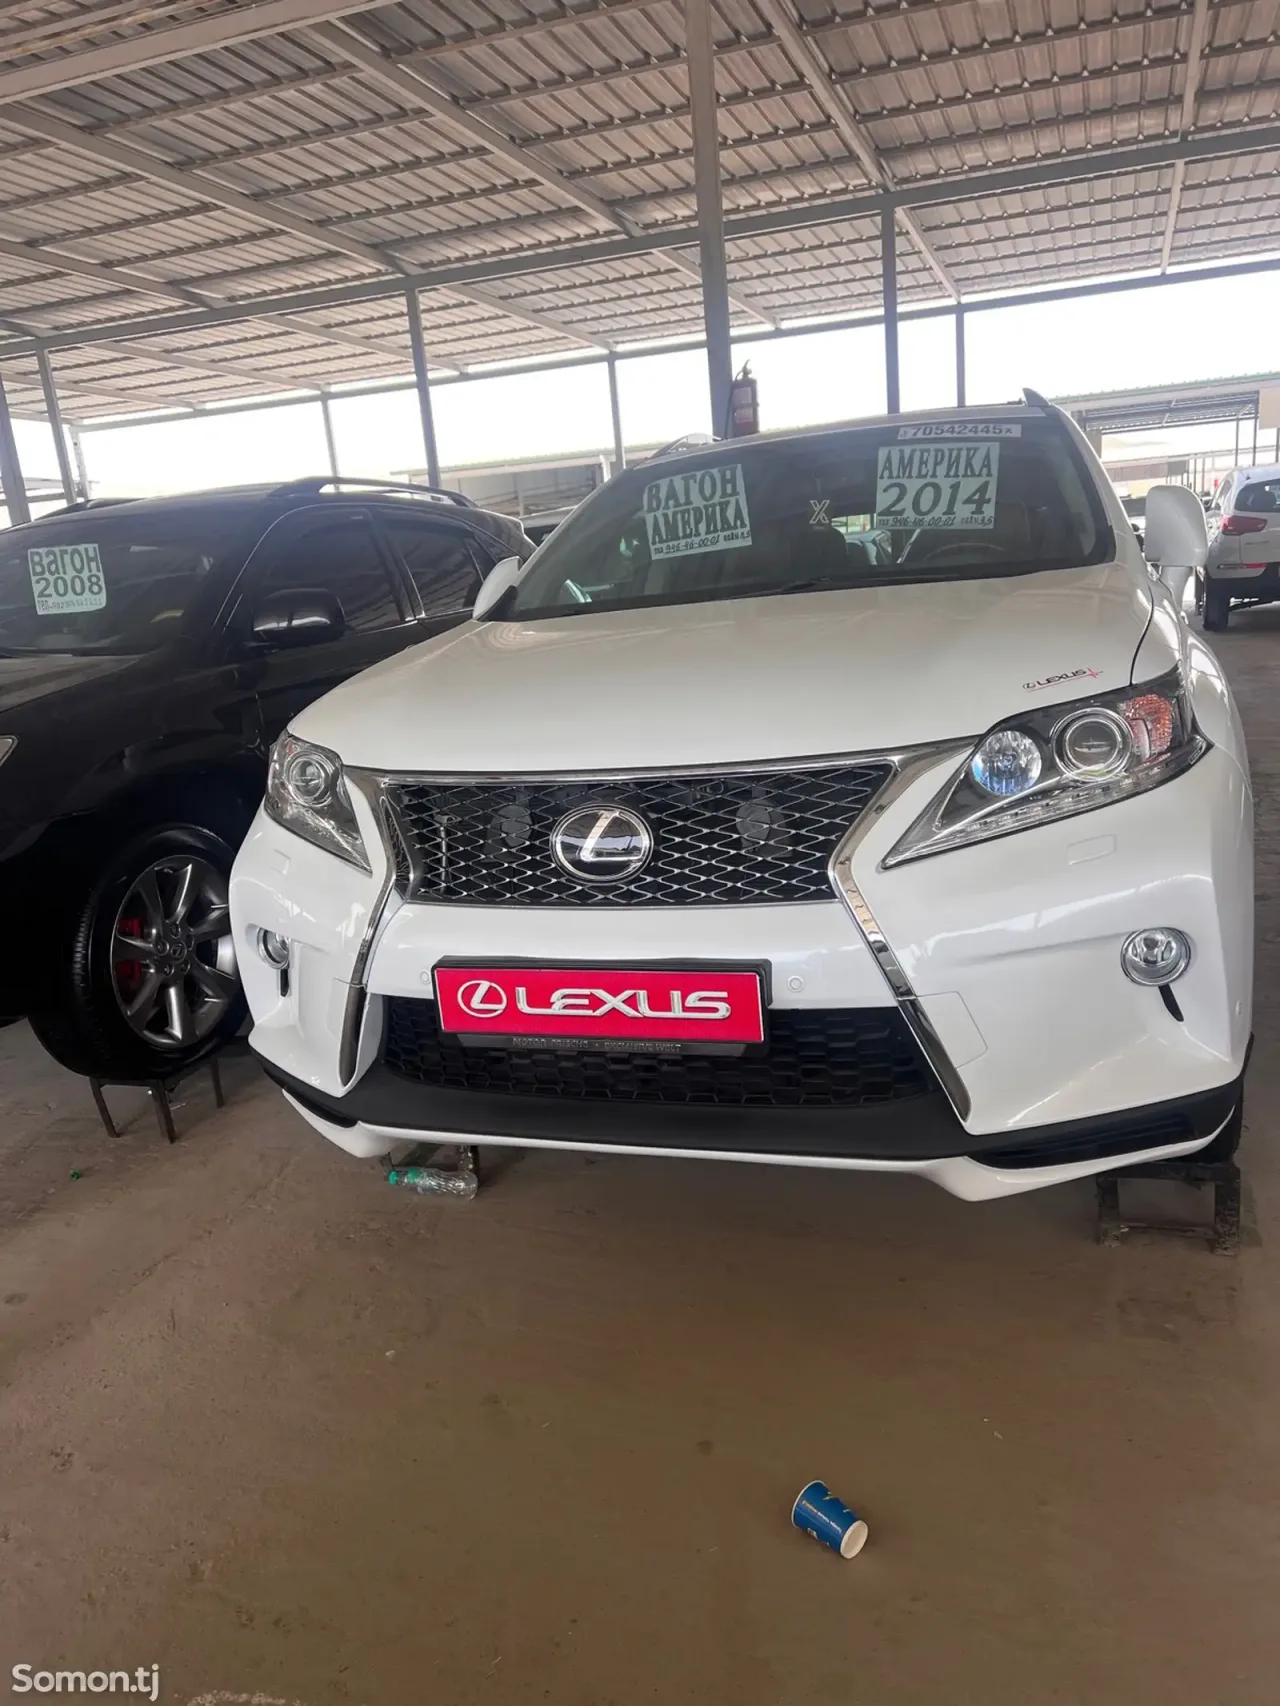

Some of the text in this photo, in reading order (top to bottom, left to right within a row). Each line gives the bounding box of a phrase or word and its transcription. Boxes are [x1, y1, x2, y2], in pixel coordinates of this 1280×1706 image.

[879, 446, 993, 479] АМЕРИКА
[645, 467, 740, 512] ВАГОН
[877, 481, 992, 516] 2014
[651, 497, 748, 545] АМЕРИКА
[35, 573, 104, 598] 2008
[1036, 669, 1087, 686] LEXUS
[515, 986, 731, 1019] LEXUS
